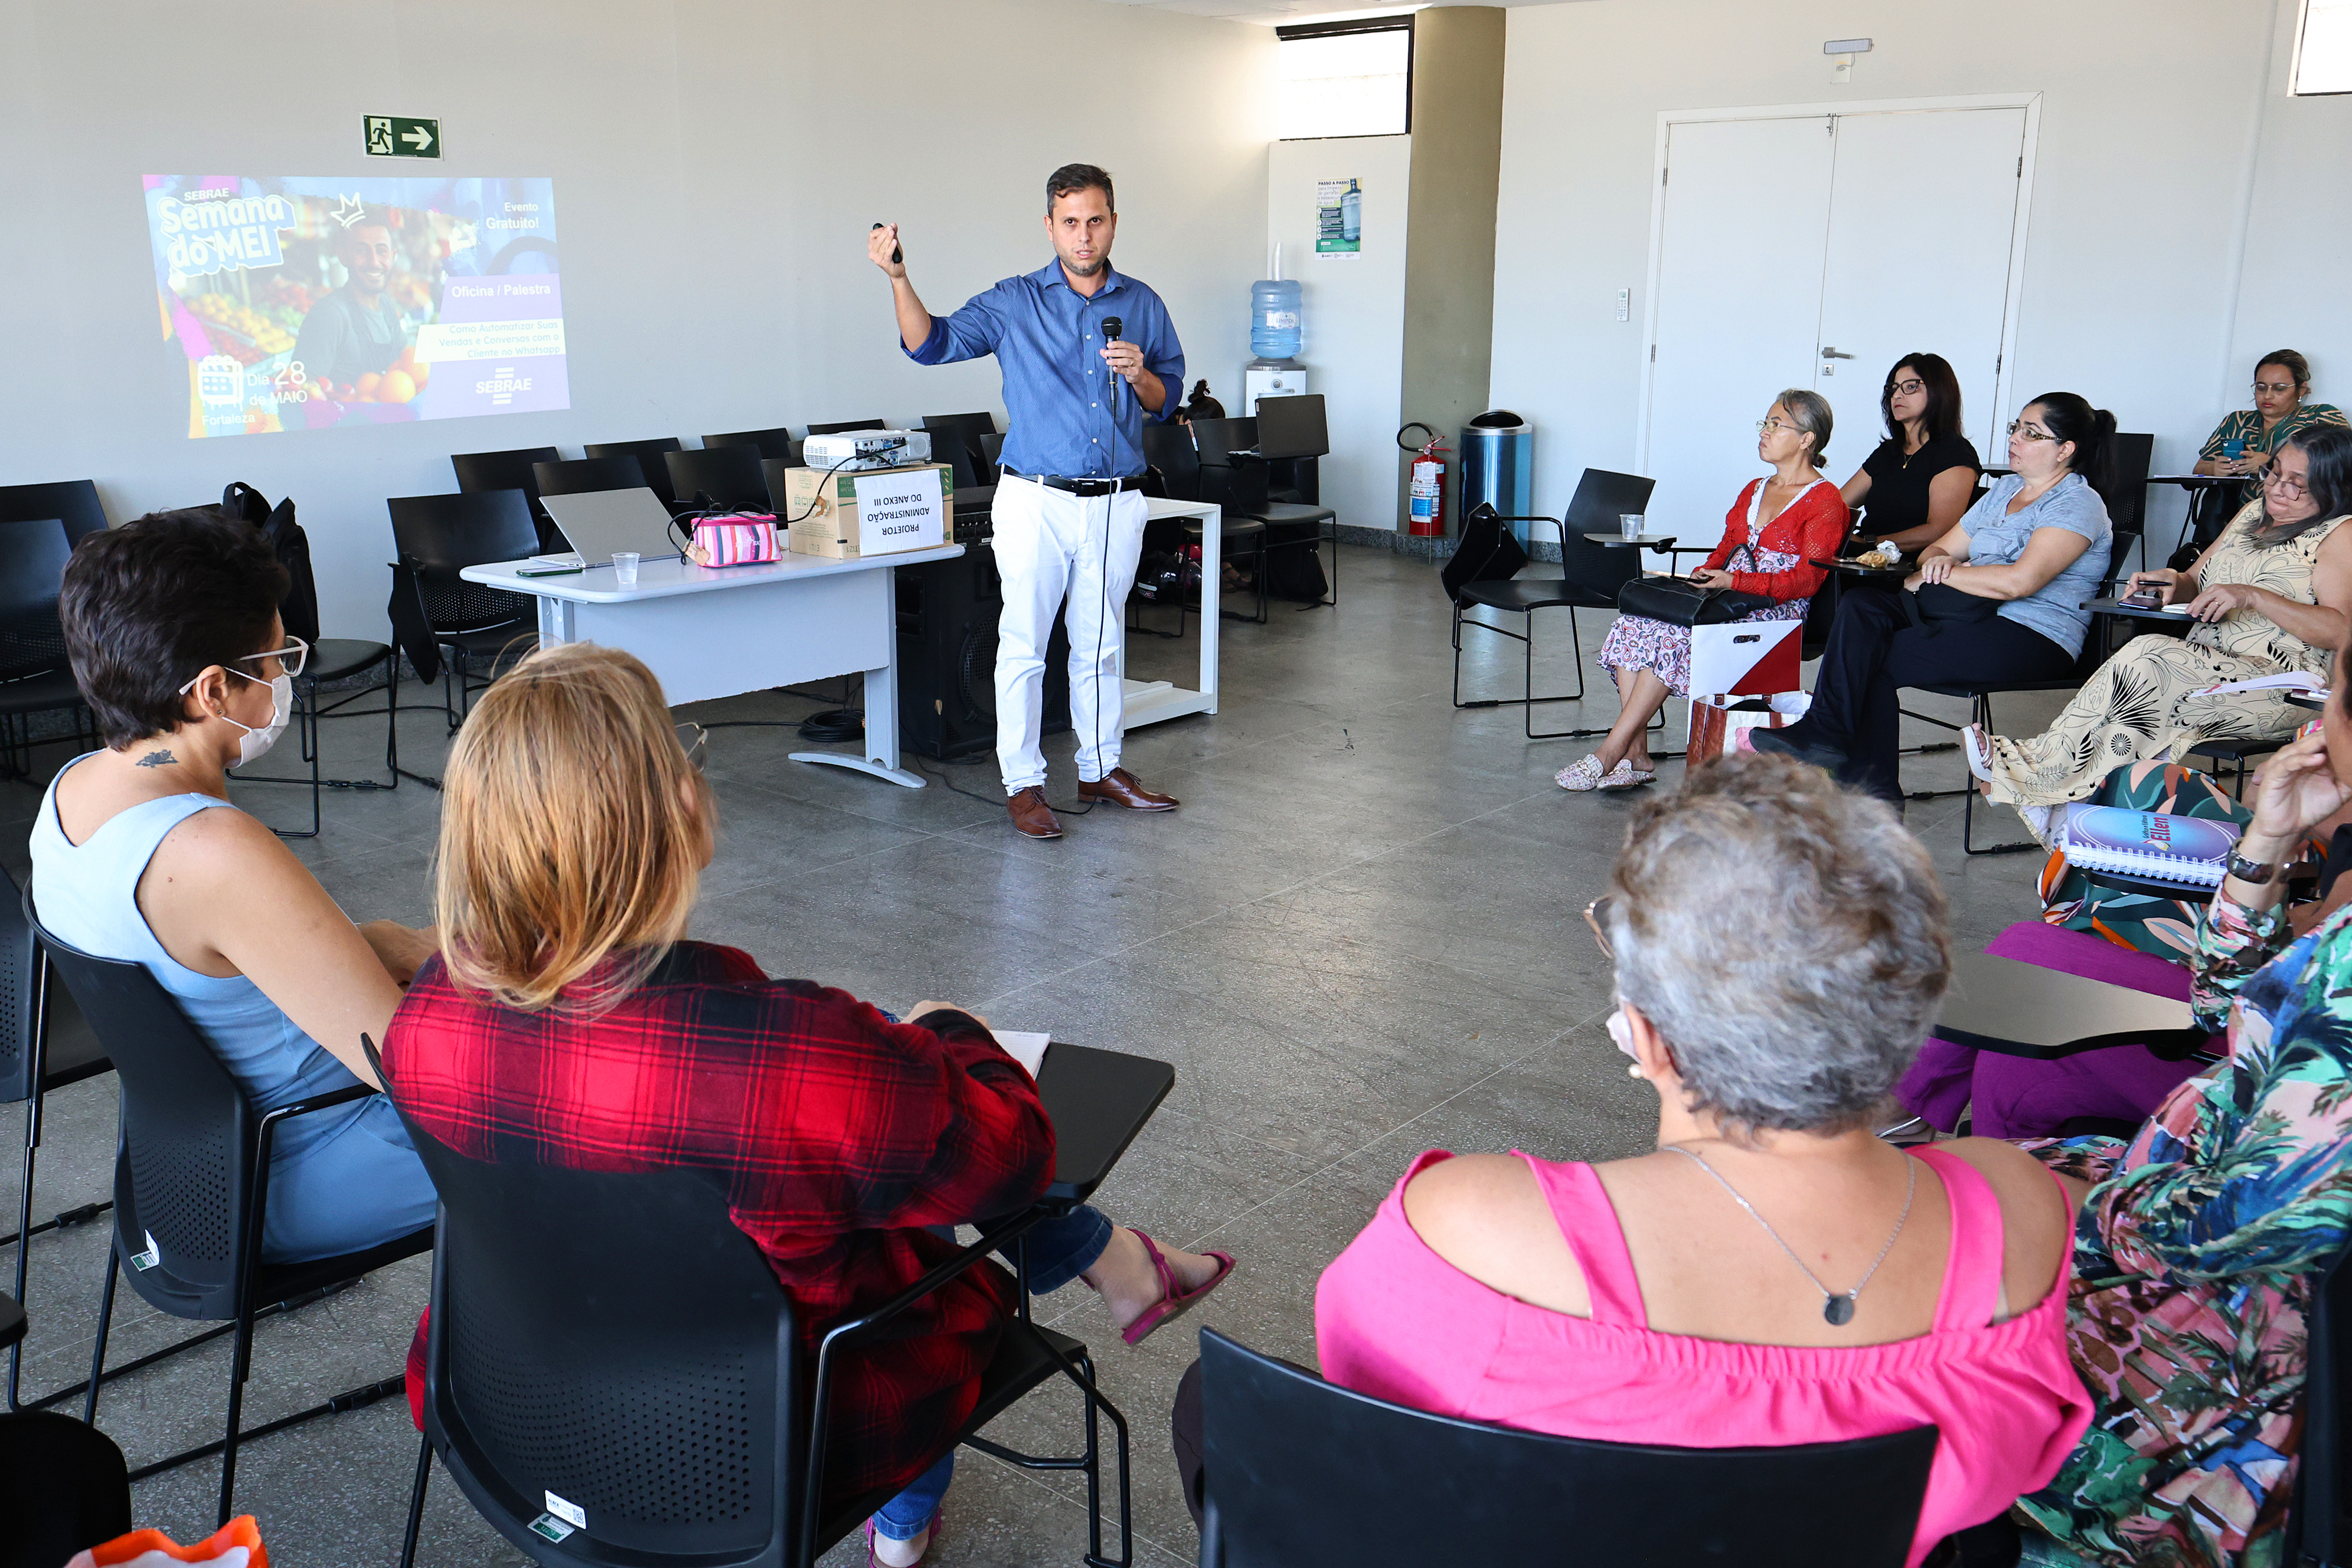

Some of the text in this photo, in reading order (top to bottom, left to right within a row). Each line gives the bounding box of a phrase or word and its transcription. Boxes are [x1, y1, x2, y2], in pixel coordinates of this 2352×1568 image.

[184, 188, 230, 201] SEBRAE
[504, 202, 538, 212] Evento
[158, 197, 285, 234] Semana
[486, 217, 539, 230] Gratuito!
[169, 224, 272, 269] do MEI
[452, 285, 495, 298] Oficina
[504, 284, 551, 296] Palestra
[449, 321, 558, 334] Como Automatizar Suas
[439, 337, 473, 347] Vendas
[484, 335, 530, 344] Conversas
[468, 348, 499, 358] Cliente
[515, 345, 560, 356] Whatsapp
[247, 361, 307, 386] Dia 28
[475, 378, 533, 394] SEBRAE
[249, 390, 308, 406] de MAIO
[201, 414, 256, 426] Fortaleza
[883, 495, 909, 505] ANEXO
[911, 494, 922, 502] DO
[867, 507, 930, 523] ADMINISTRAÇÃO
[881, 523, 920, 536] PROJETOR
[2150, 817, 2171, 841] Ellen
